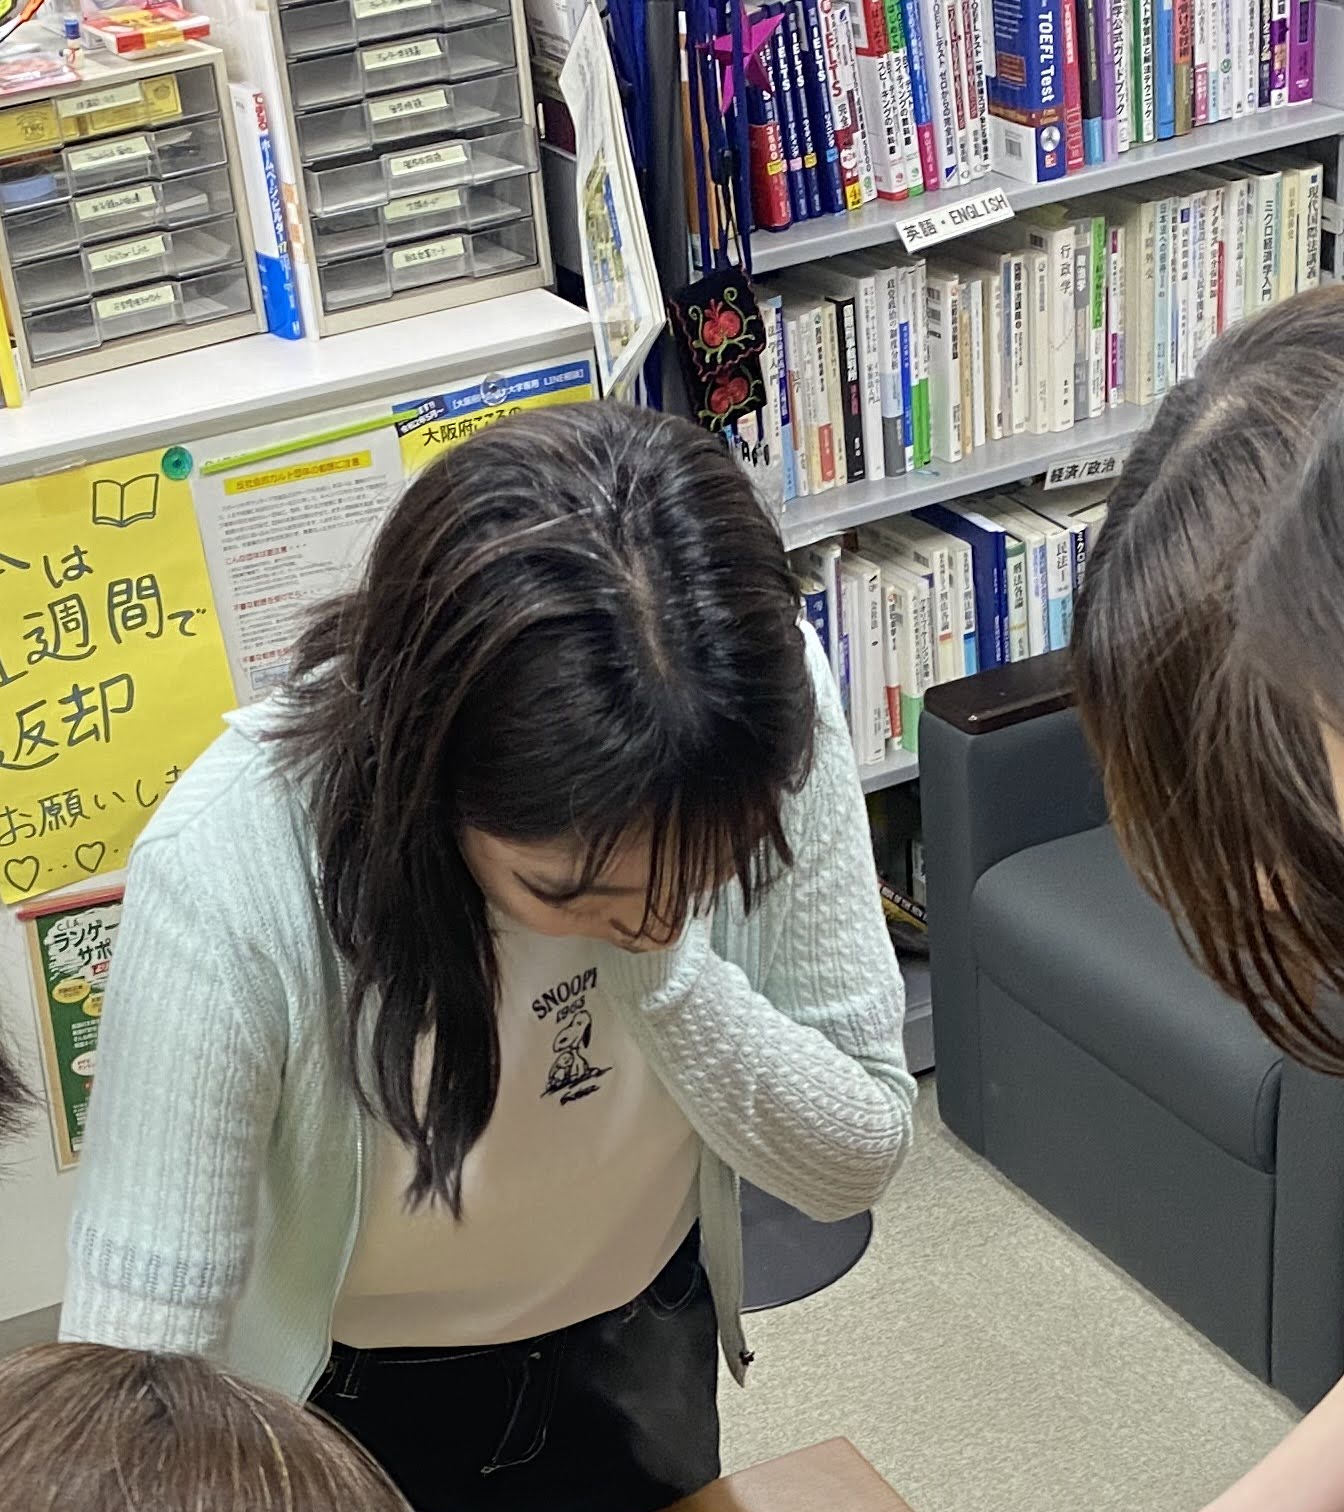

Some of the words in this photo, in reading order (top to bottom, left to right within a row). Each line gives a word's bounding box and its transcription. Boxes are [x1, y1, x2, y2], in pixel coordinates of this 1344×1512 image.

[777, 35, 791, 91] IELTS
[792, 32, 805, 88] IELTS
[813, 26, 827, 82] IELTS
[823, 16, 843, 98] IELTS
[1038, 11, 1054, 63] TOEFL
[1040, 64, 1055, 104] Test
[1060, 243, 1073, 295] 行政学
[1261, 200, 1274, 302] ミクロ経済学入門
[1050, 456, 1116, 482] 経済/政治
[1012, 561, 1024, 610] 刑法各論
